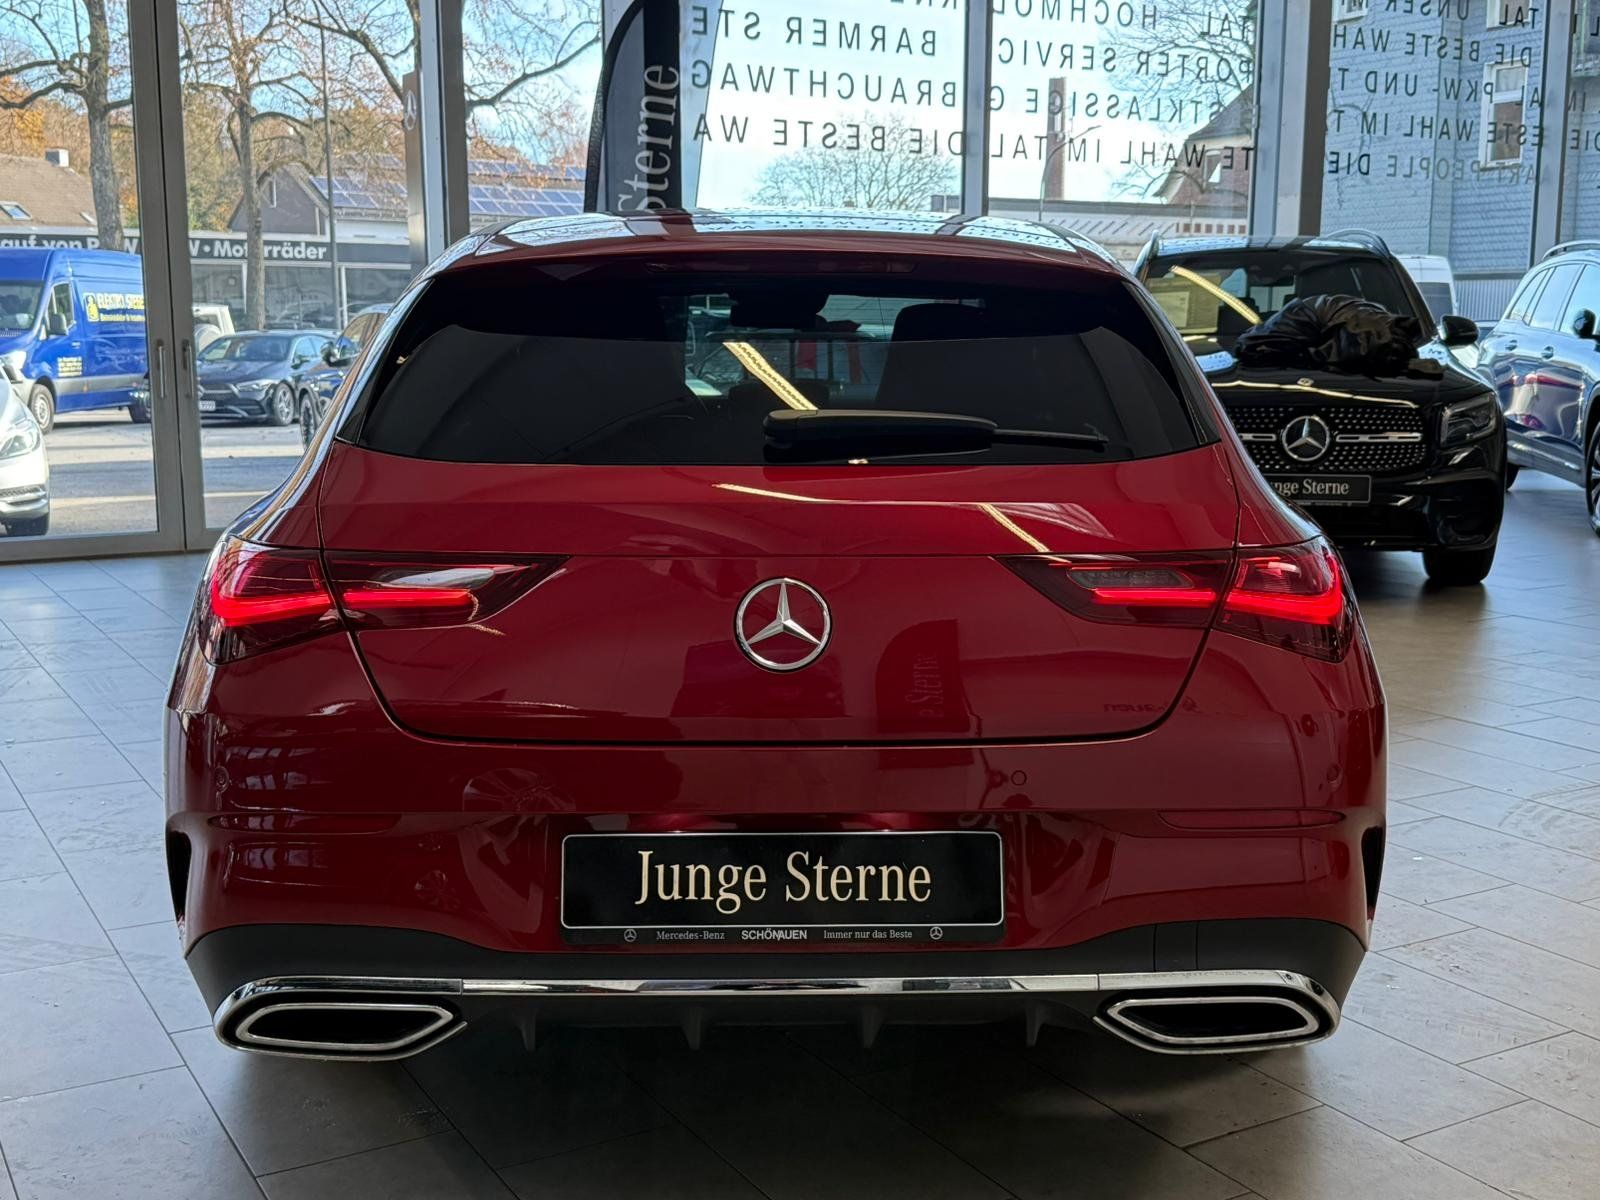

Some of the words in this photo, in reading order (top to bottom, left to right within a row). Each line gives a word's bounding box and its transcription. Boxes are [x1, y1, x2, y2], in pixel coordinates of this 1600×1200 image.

[213, 238, 327, 260] Motrräder
[1302, 478, 1350, 496] Sterne
[635, 849, 768, 915] Junge
[785, 850, 932, 902] Sterne
[656, 929, 726, 941] Mercedes-Benz
[823, 928, 853, 940] Immer
[854, 930, 871, 939] nur
[872, 928, 888, 939] das
[890, 927, 913, 939] Beste
